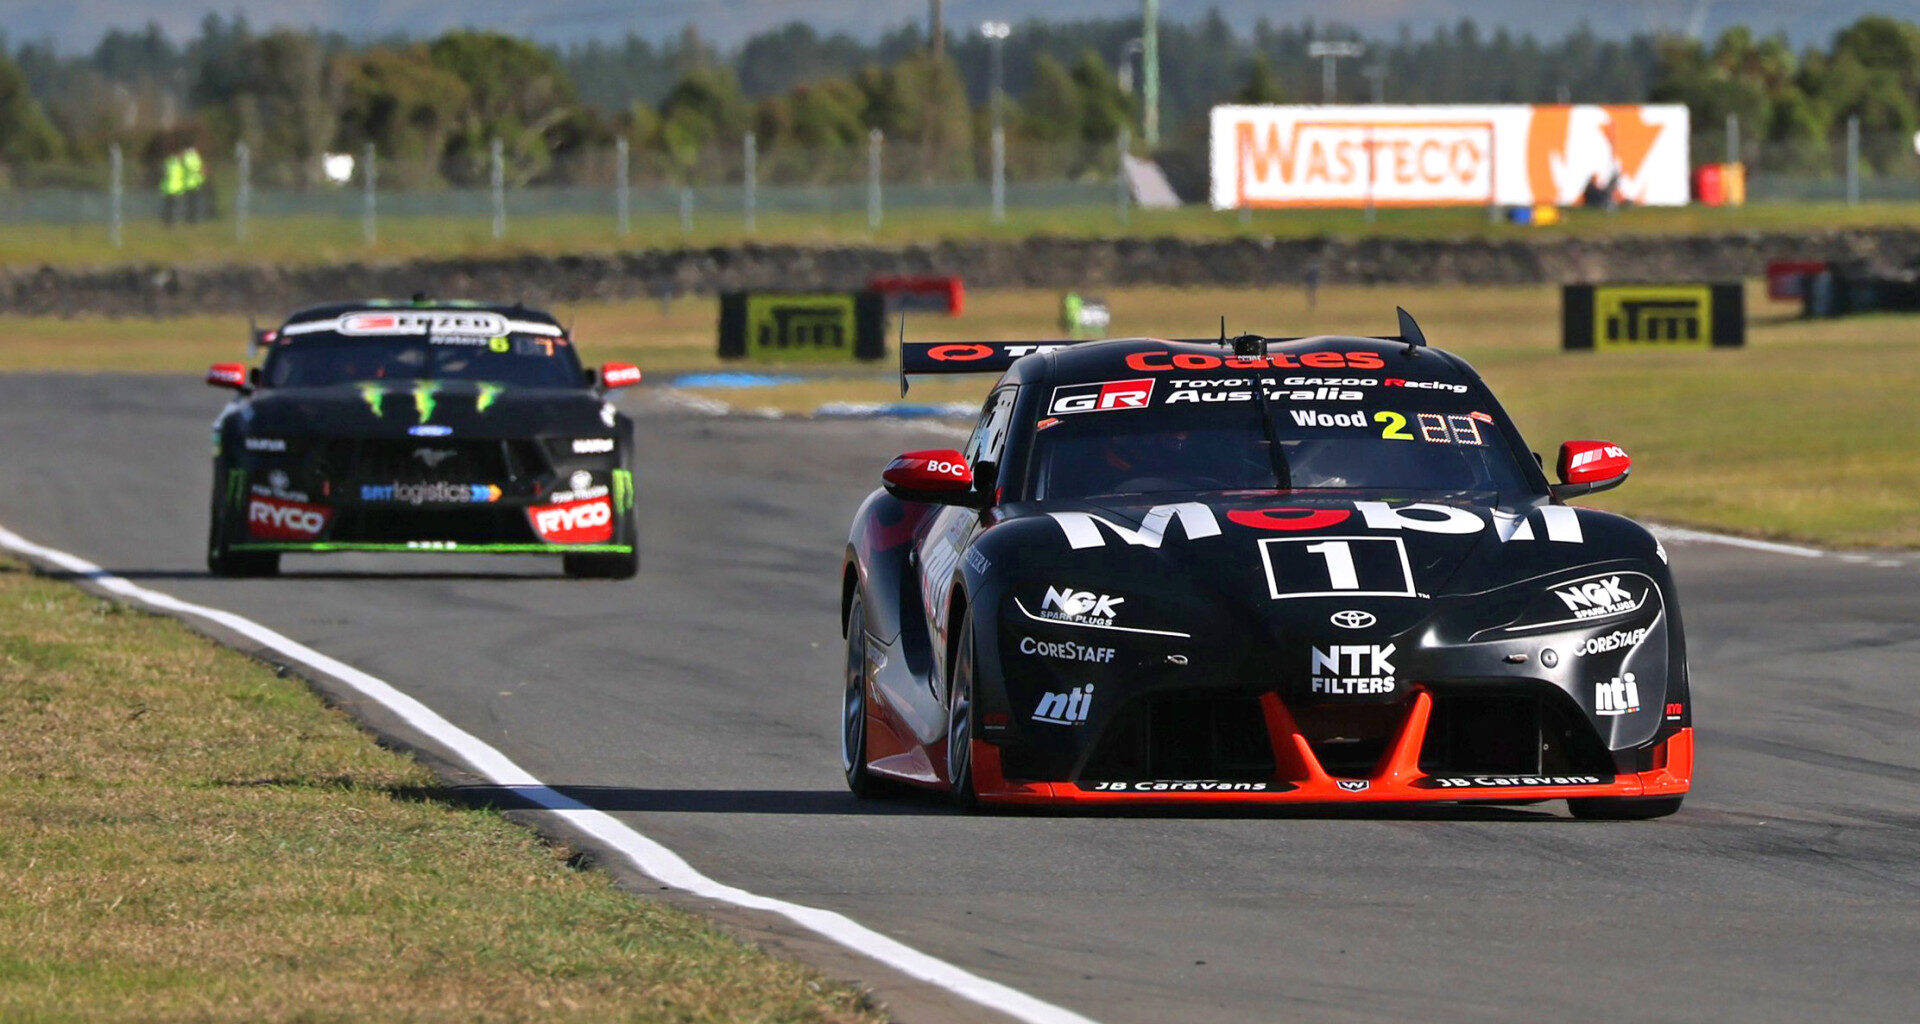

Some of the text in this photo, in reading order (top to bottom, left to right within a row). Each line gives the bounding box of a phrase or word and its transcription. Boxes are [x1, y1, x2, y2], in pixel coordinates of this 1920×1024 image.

[489, 335, 510, 352] 6
[1125, 351, 1385, 372] Coates
[1165, 387, 1364, 404] Australia
[1169, 377, 1468, 394] TOYOTA GAZOO Racing
[1053, 390, 1148, 413] GR
[1290, 410, 1368, 428] Wood
[1373, 411, 1414, 440] 2
[926, 460, 965, 476] BOC
[250, 501, 325, 534] RYCO
[535, 502, 611, 534] RYCO
[1046, 501, 1583, 549] Mobil
[1306, 541, 1360, 589] 1
[1041, 585, 1125, 618] NGK
[1554, 576, 1631, 610] NGK
[1040, 610, 1113, 626] SPARK PLUGS
[1574, 607, 1607, 618] SPARK
[1312, 643, 1396, 676] NTK
[1312, 677, 1395, 694] FILTERS
[1596, 672, 1640, 710] nti
[1034, 683, 1095, 721] nti
[1095, 781, 1267, 791] JB Caravans
[1436, 775, 1600, 787] JB Caravans
